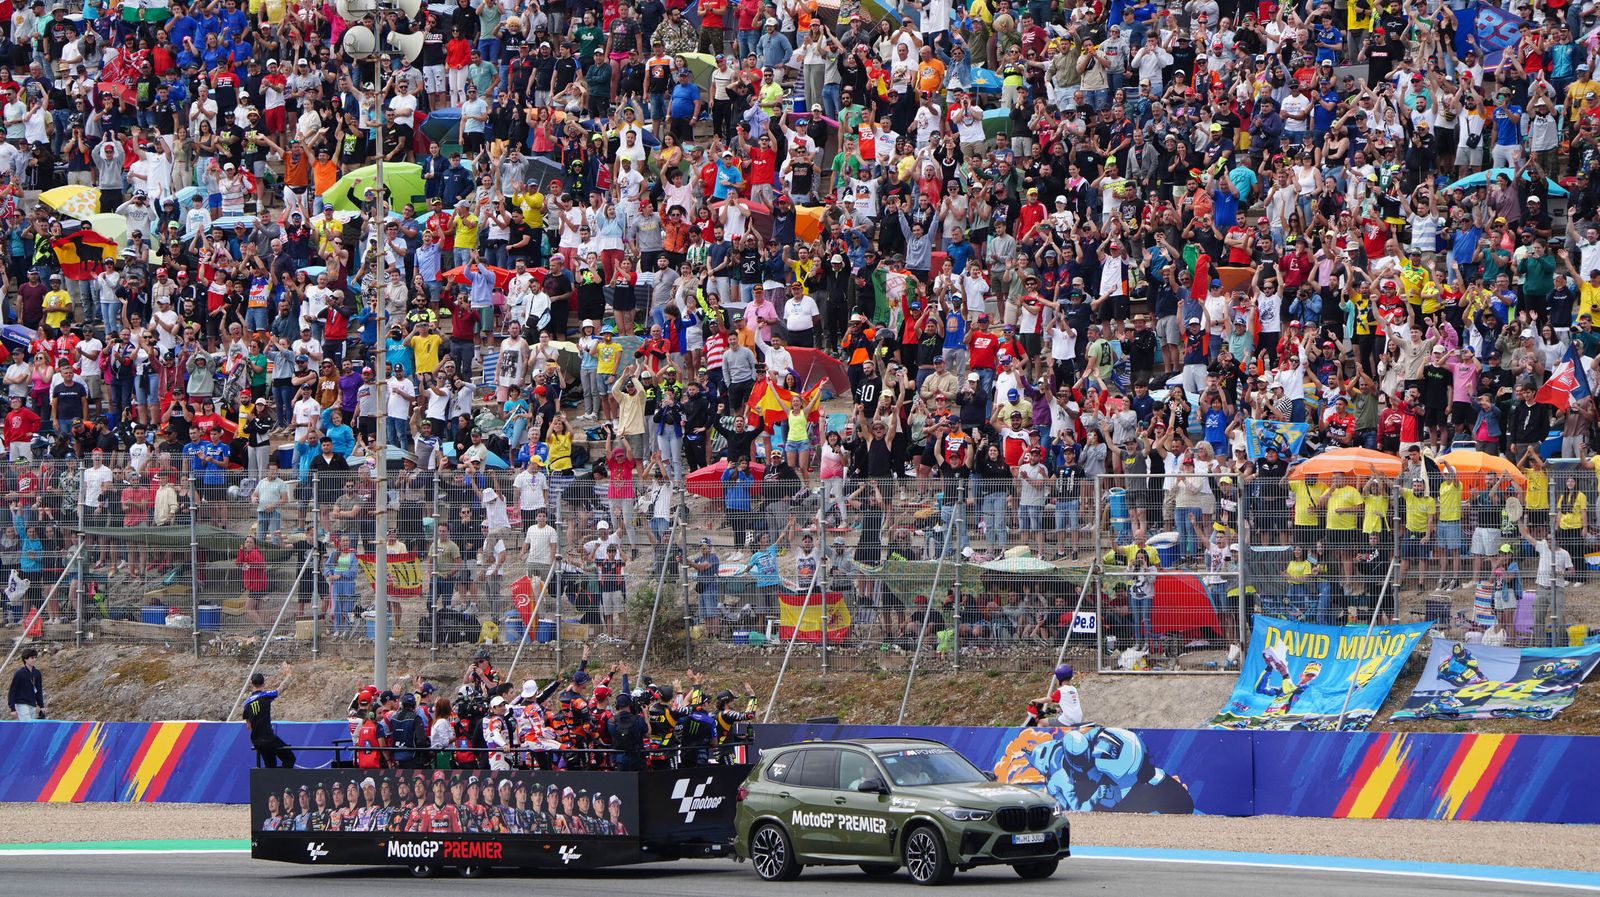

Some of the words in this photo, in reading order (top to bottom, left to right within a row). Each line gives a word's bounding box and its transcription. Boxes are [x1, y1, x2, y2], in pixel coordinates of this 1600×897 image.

[1475, 8, 1521, 48] 89
[861, 384, 875, 402] 10
[1074, 615, 1096, 629] Pe.8
[1264, 626, 1330, 660] DAVID
[1454, 680, 1543, 701] 44
[791, 810, 835, 829] MotoGP
[838, 814, 887, 834] PREMIER
[387, 840, 441, 859] MotoGP
[443, 841, 502, 859] PREMIER
